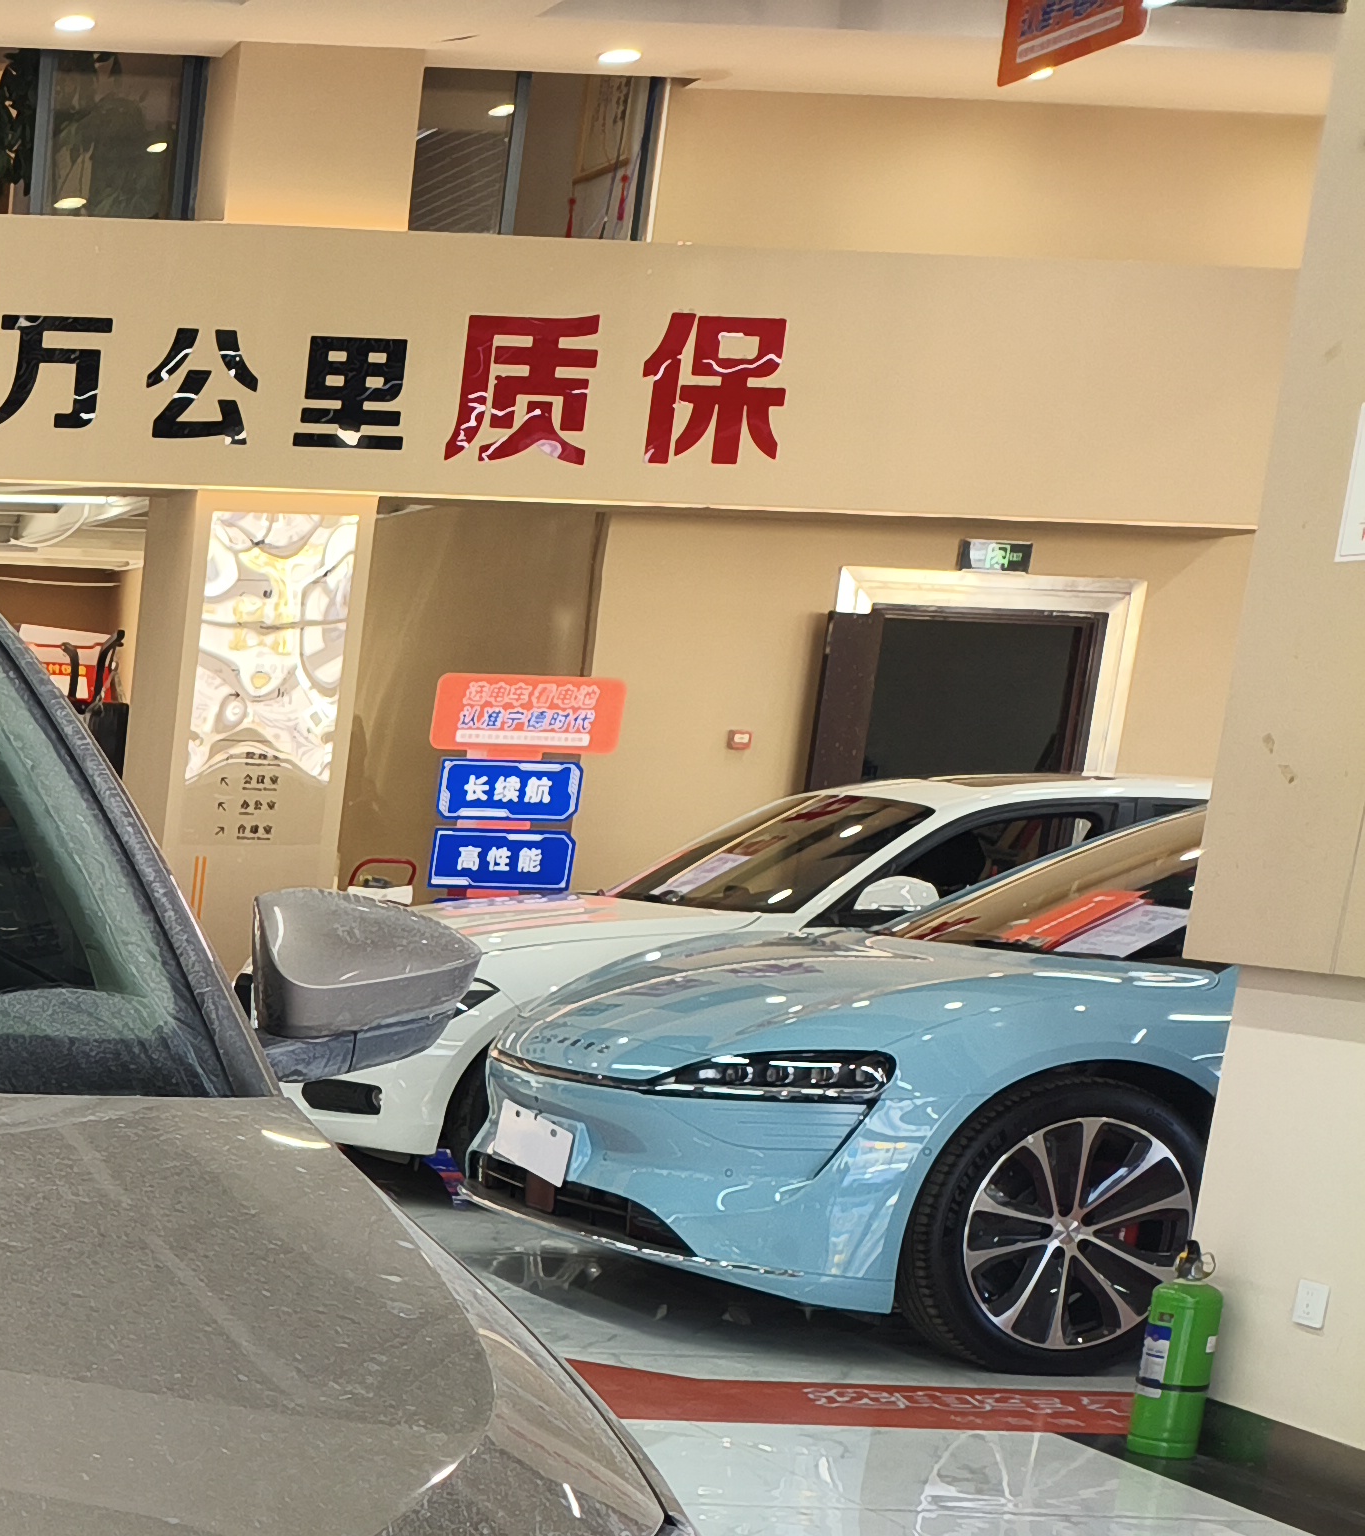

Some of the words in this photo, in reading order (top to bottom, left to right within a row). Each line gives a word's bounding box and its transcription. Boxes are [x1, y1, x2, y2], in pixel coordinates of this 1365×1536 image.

[458, 706, 596, 732] 认准宁德时代
[464, 774, 553, 804] 长续航
[456, 845, 543, 873] 高性能
